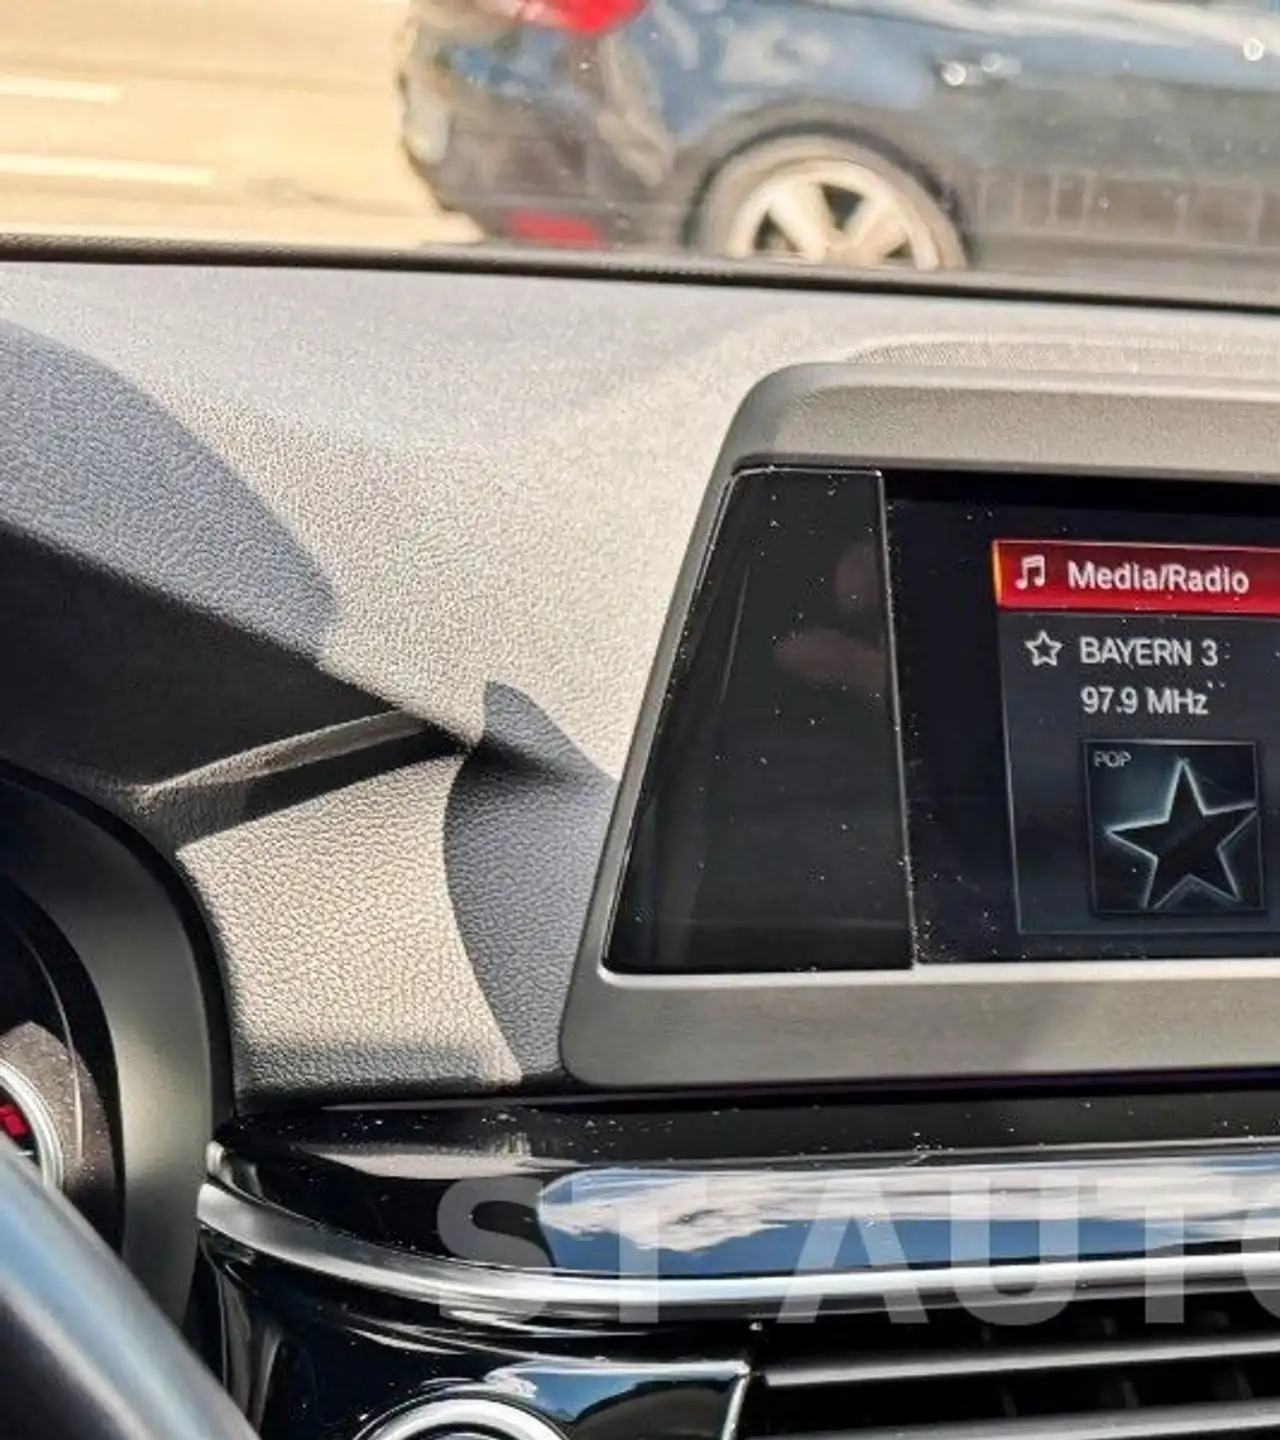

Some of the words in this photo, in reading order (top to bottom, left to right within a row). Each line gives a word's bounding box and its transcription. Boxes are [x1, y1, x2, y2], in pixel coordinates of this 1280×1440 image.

[1067, 560, 1251, 595] Media/Radio
[1078, 637, 1194, 668] BAYERN
[1200, 640, 1219, 668] 3
[1080, 686, 1139, 716] 97.9
[1147, 687, 1210, 716] MHz
[1093, 750, 1132, 769] POP
